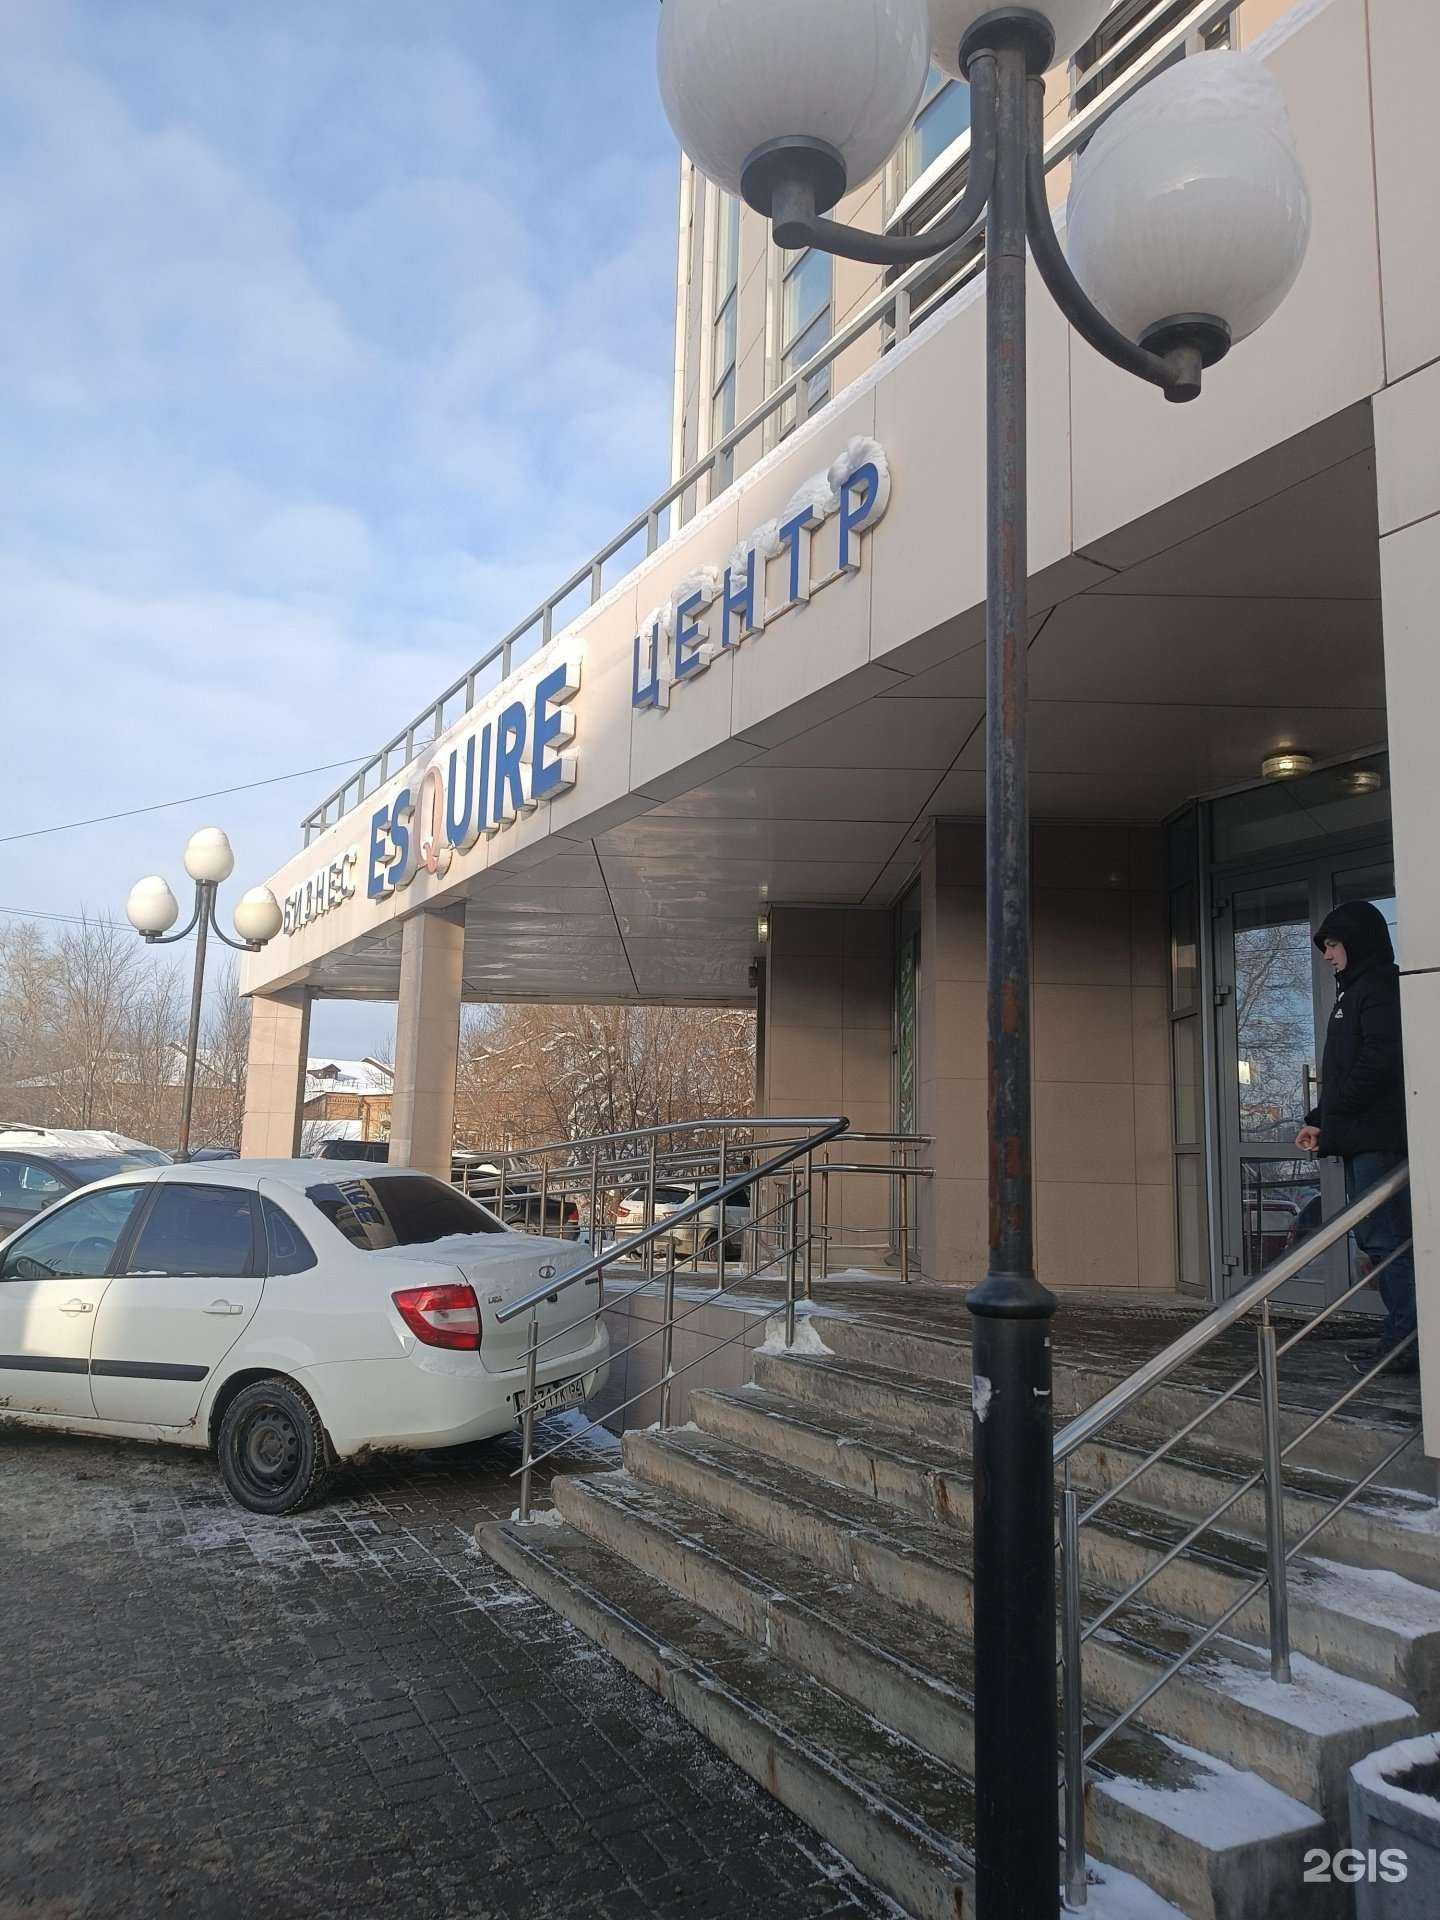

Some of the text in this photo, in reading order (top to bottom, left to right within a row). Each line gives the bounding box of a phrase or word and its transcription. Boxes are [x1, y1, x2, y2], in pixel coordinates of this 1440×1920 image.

[283, 462, 886, 936] БИЗНЕС ESQUIRE ЦЕНТР
